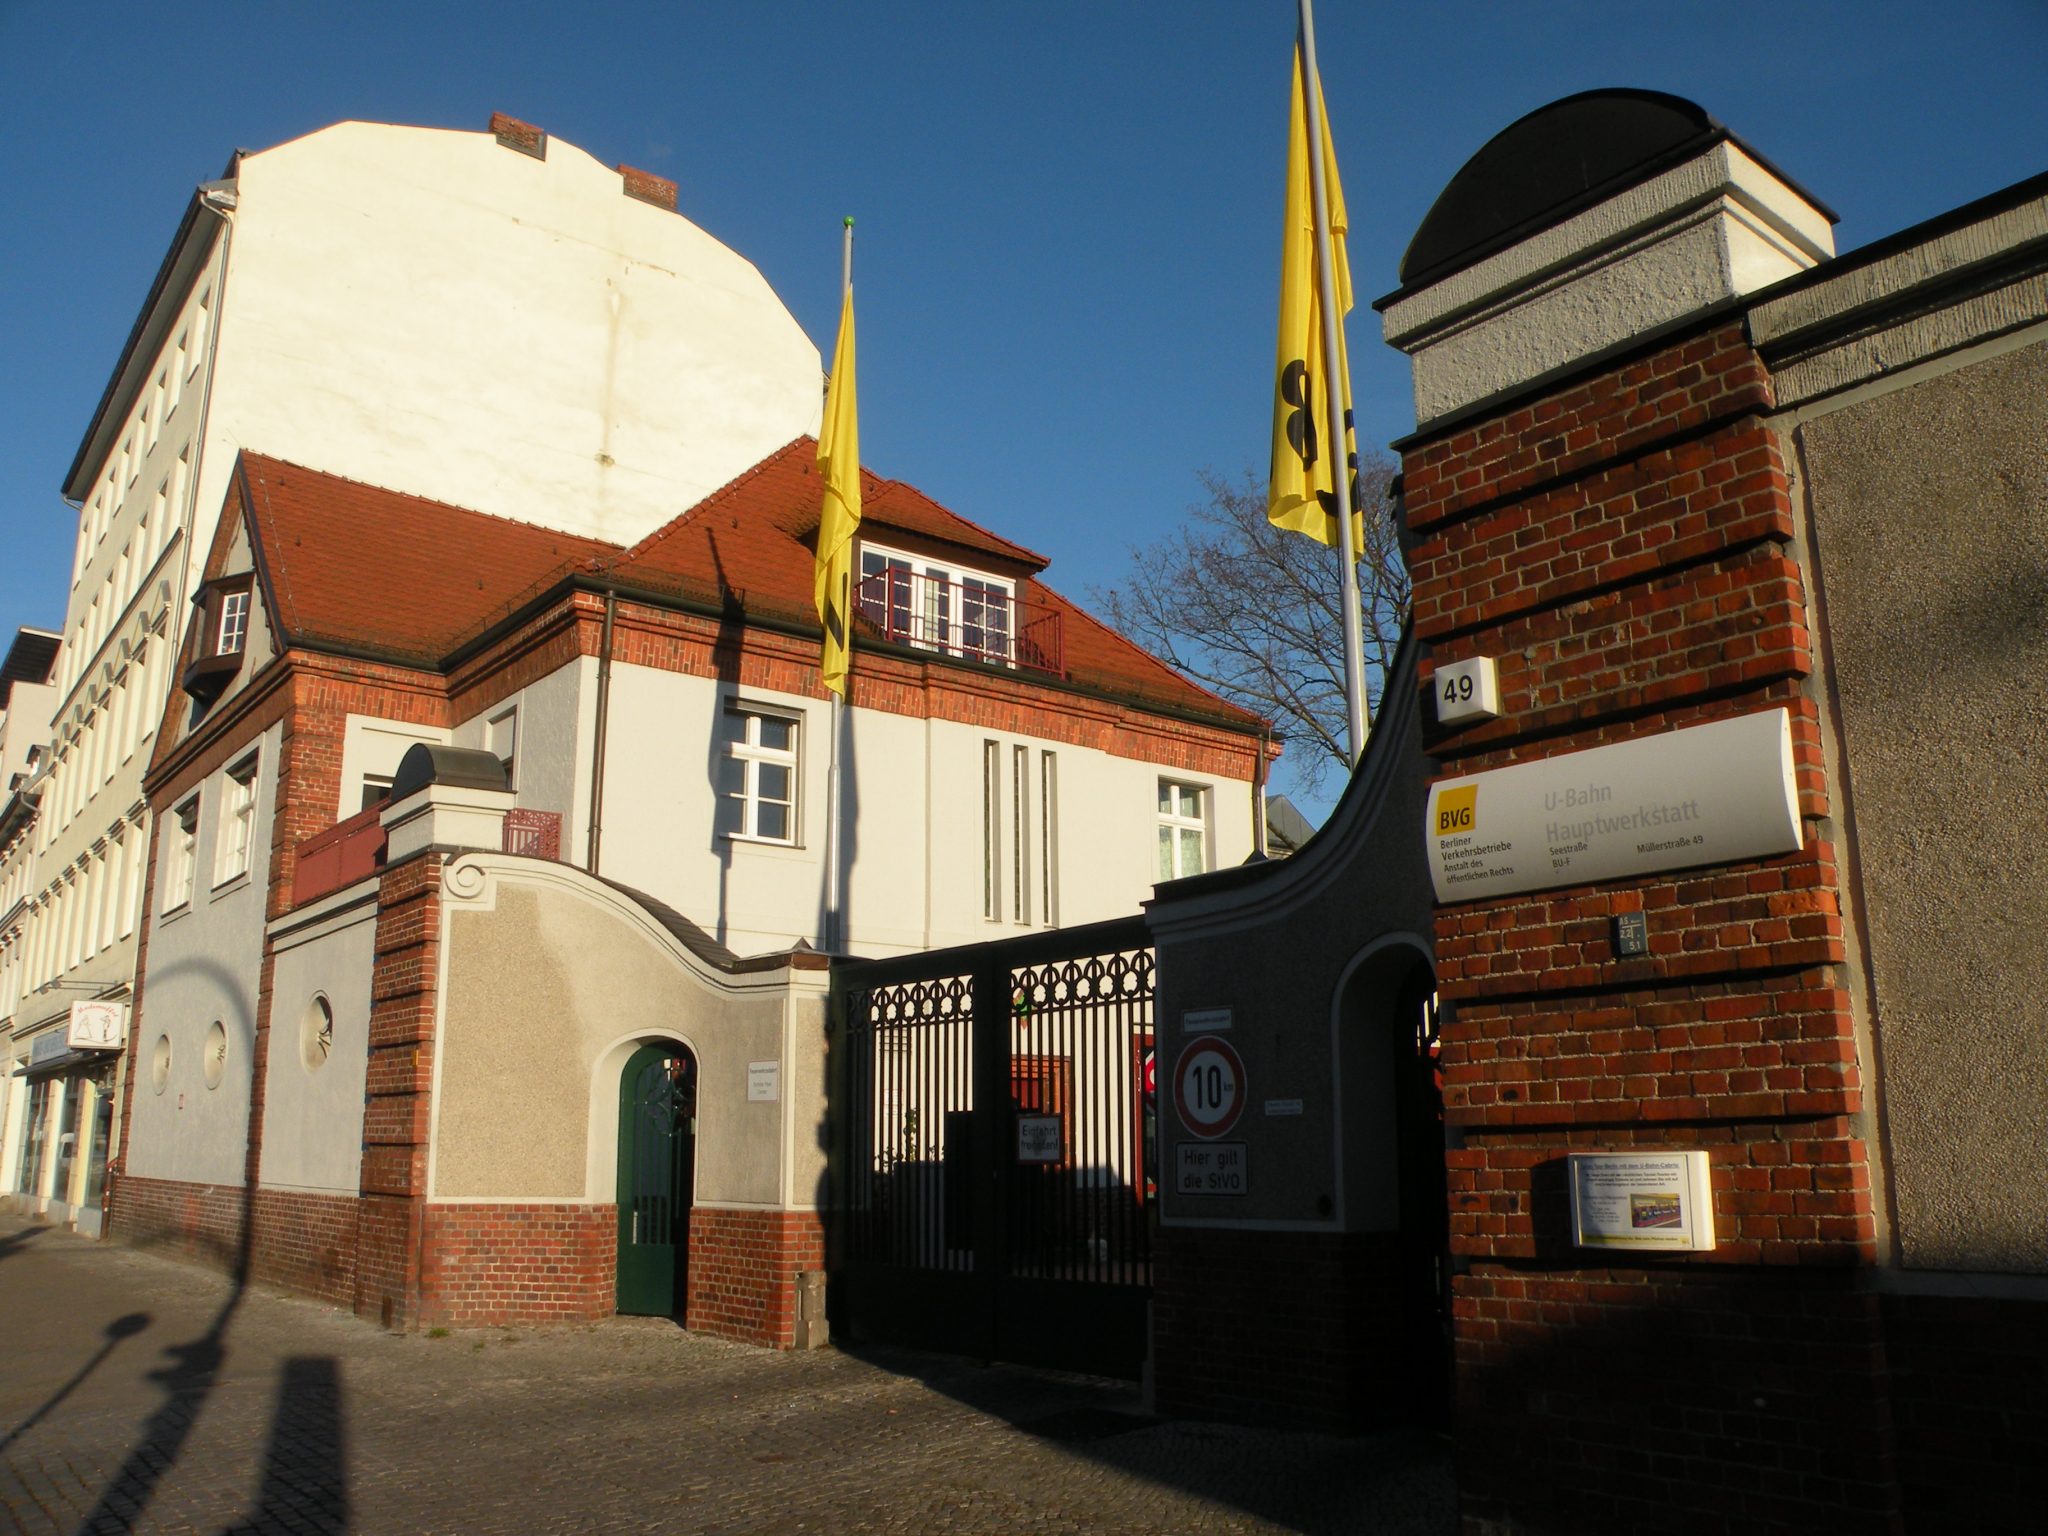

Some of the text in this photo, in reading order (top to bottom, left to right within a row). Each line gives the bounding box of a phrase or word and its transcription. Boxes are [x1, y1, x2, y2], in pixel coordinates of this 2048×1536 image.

[1444, 675, 1473, 703] 49
[1544, 784, 1611, 811] U-Bahn
[1440, 807, 1470, 830] BVG
[1546, 799, 1700, 843] Hauptwerkstatt
[1440, 837, 1471, 849] Berliner
[1441, 841, 1512, 861] Verkehrsbetriebe
[1549, 841, 1588, 856] Seestraße
[1636, 835, 1704, 854] Müllerstraße 49
[1444, 859, 1483, 873] Anstalt des
[1446, 866, 1515, 884] öffentlichen Rechts
[1192, 1065, 1222, 1109] 10
[1184, 1150, 1238, 1169] Hier gilt
[1184, 1172, 1239, 1189] die StVO
